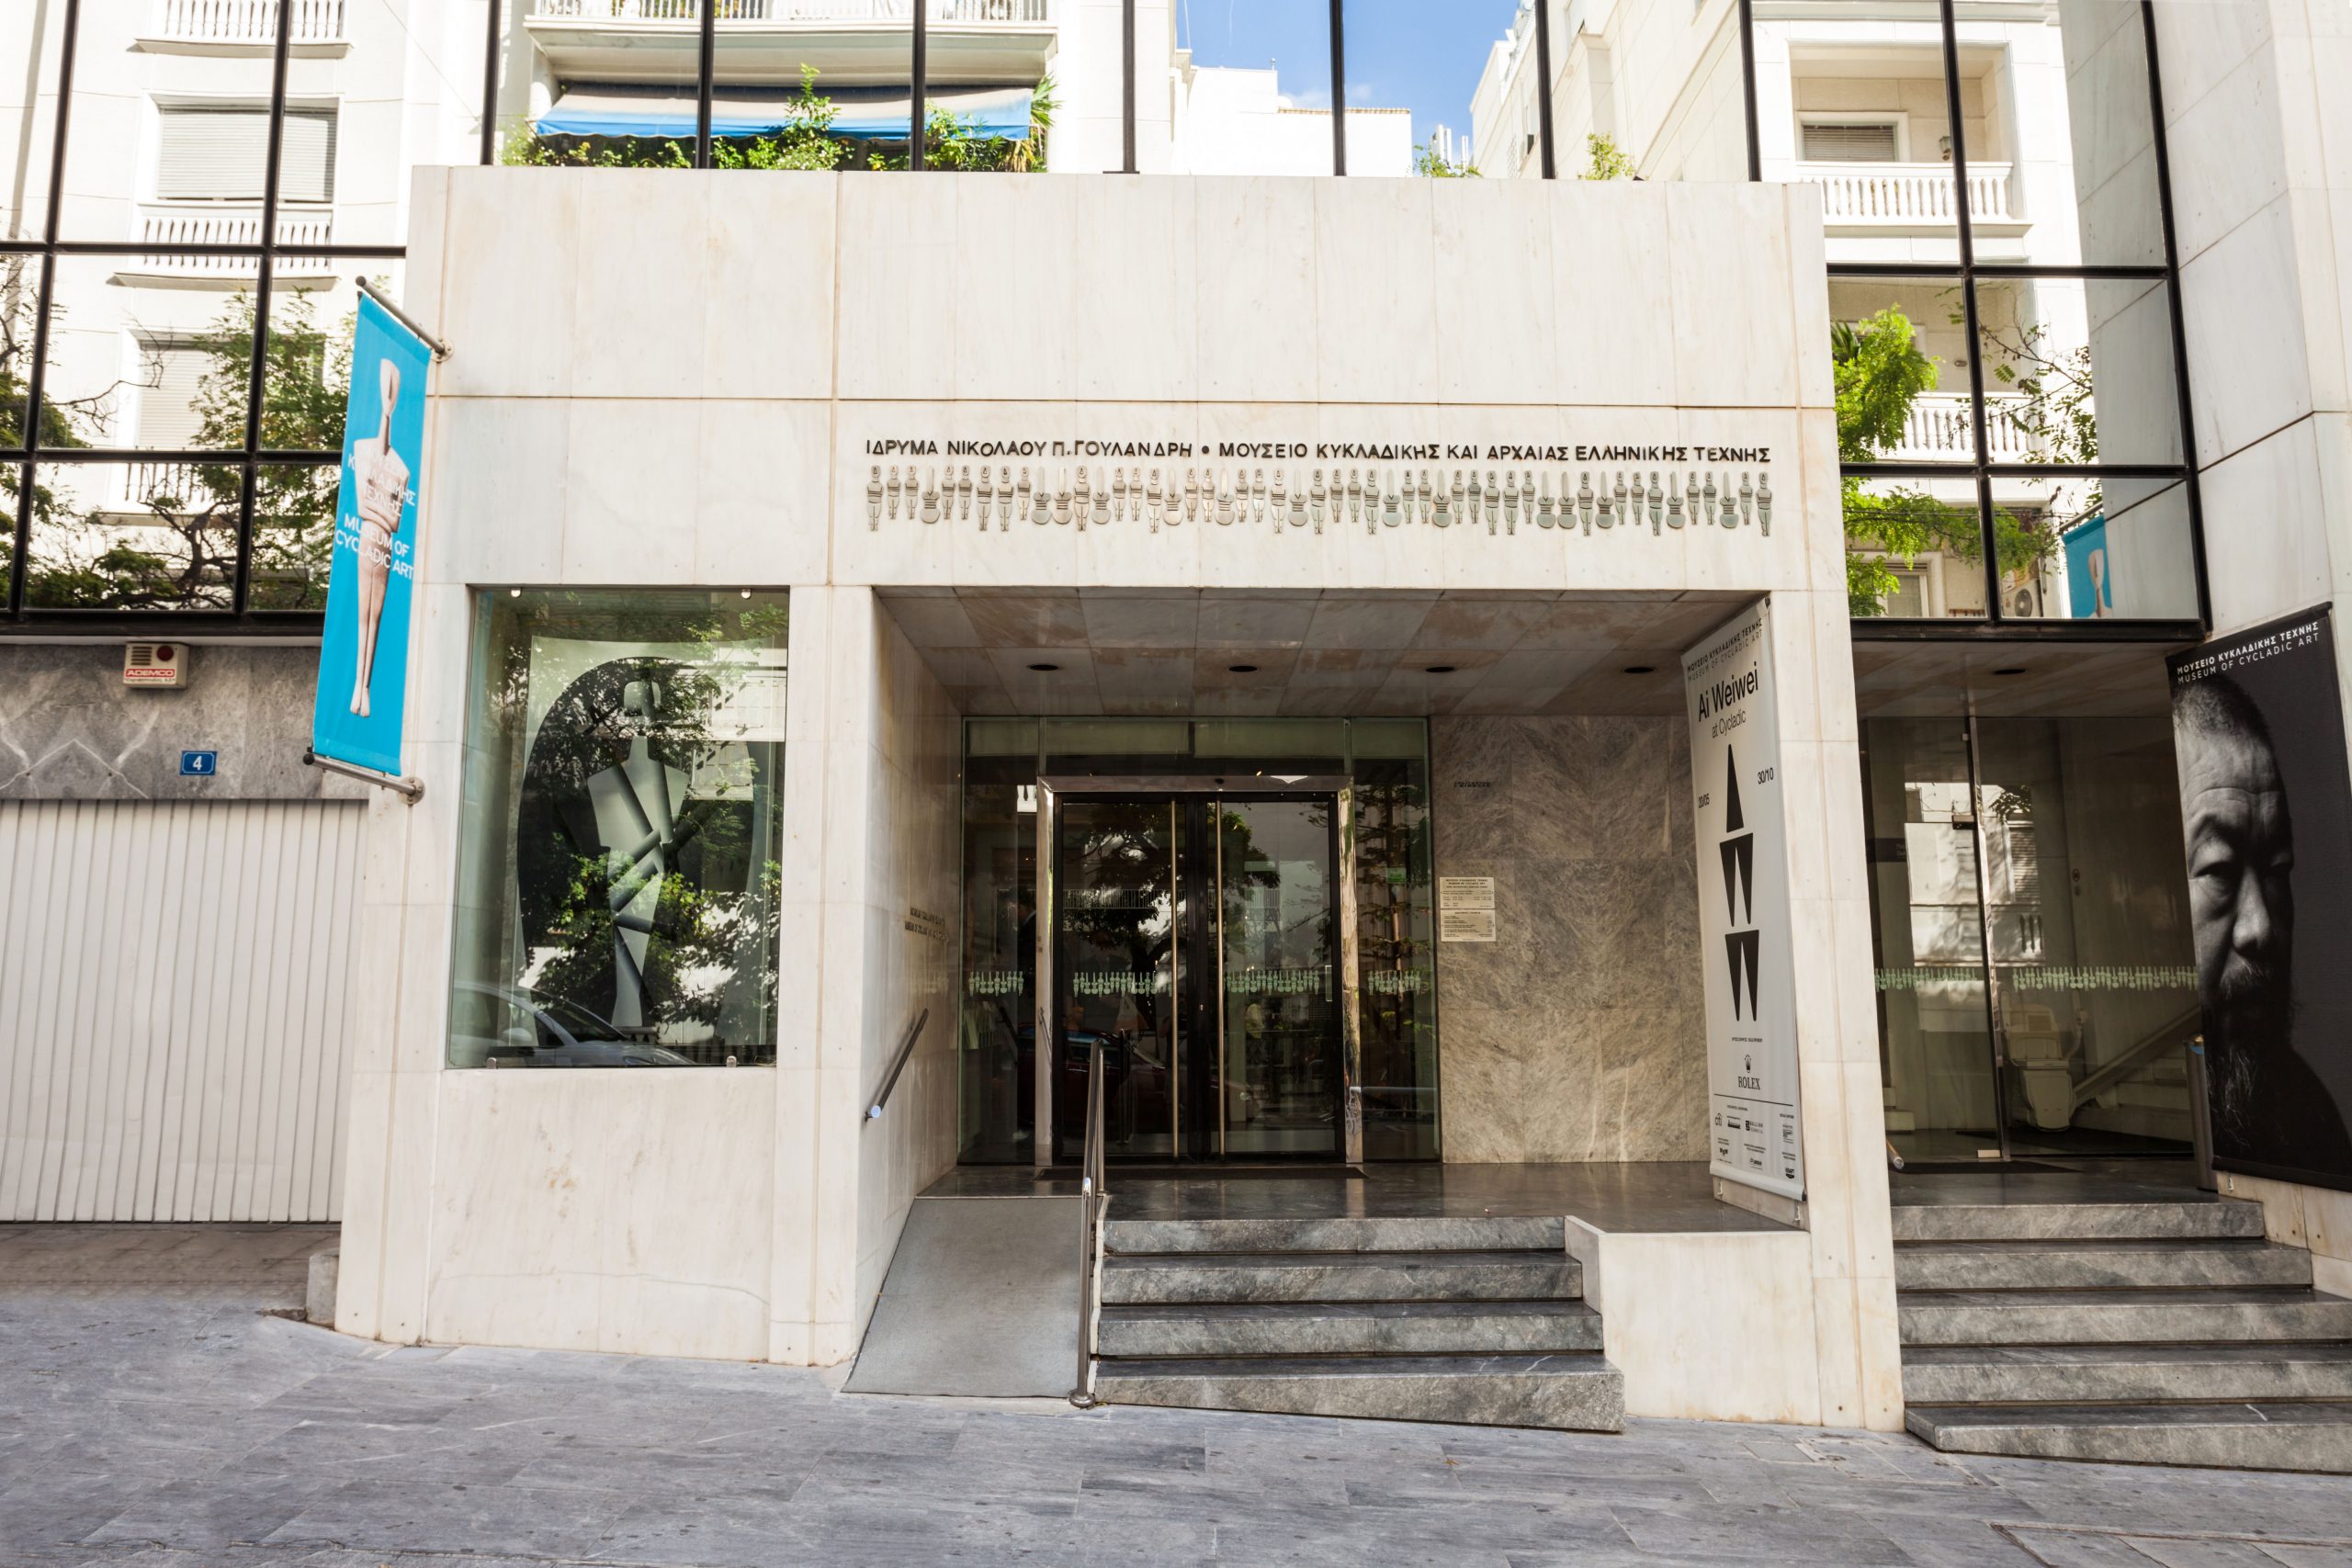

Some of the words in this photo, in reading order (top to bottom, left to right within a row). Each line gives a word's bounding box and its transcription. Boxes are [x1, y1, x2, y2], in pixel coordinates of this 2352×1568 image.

[865, 439, 939, 456] ΙΔΡΥΜΑ
[947, 440, 1047, 457] ΝΙΚΟΛΑΟΥ
[1219, 442, 1308, 459] ΜΟΥΣΕΙΟ
[1317, 443, 1441, 460] ΚΥΚΛΑΔΙΚΗΣ
[1447, 444, 1477, 460] ΚΑΙ
[1487, 445, 1569, 461] ΑΡΧΑΙΑΣ
[1575, 445, 1688, 462] ΕΛΛΗΝΙΚΗΣ
[1692, 446, 1771, 463] ΤΕΧΝΗΣ
[394, 540, 410, 558] OF
[392, 559, 413, 580] ART
[1751, 629, 1762, 642] ART
[2177, 656, 2215, 675] ΜΟΥΣΕΙΟ
[2218, 636, 2277, 662] ΚΥΚΛΑΔΙΚΗΣ
[2279, 621, 2319, 642] ΤΕΧΝΗΣ
[2177, 665, 2217, 685] MUSEUM
[2221, 660, 2234, 671] OF
[2239, 642, 2292, 666] CYCLADIC
[2298, 632, 2319, 648] ART
[1699, 689, 1710, 722] Ai
[1712, 661, 1758, 714] Weiwei
[1712, 722, 1717, 739] at
[1719, 710, 1747, 736] Cycladic
[192, 755, 202, 771] 4
[1758, 767, 1774, 785] 30/10
[1737, 1076, 1761, 1090] ROLEX
